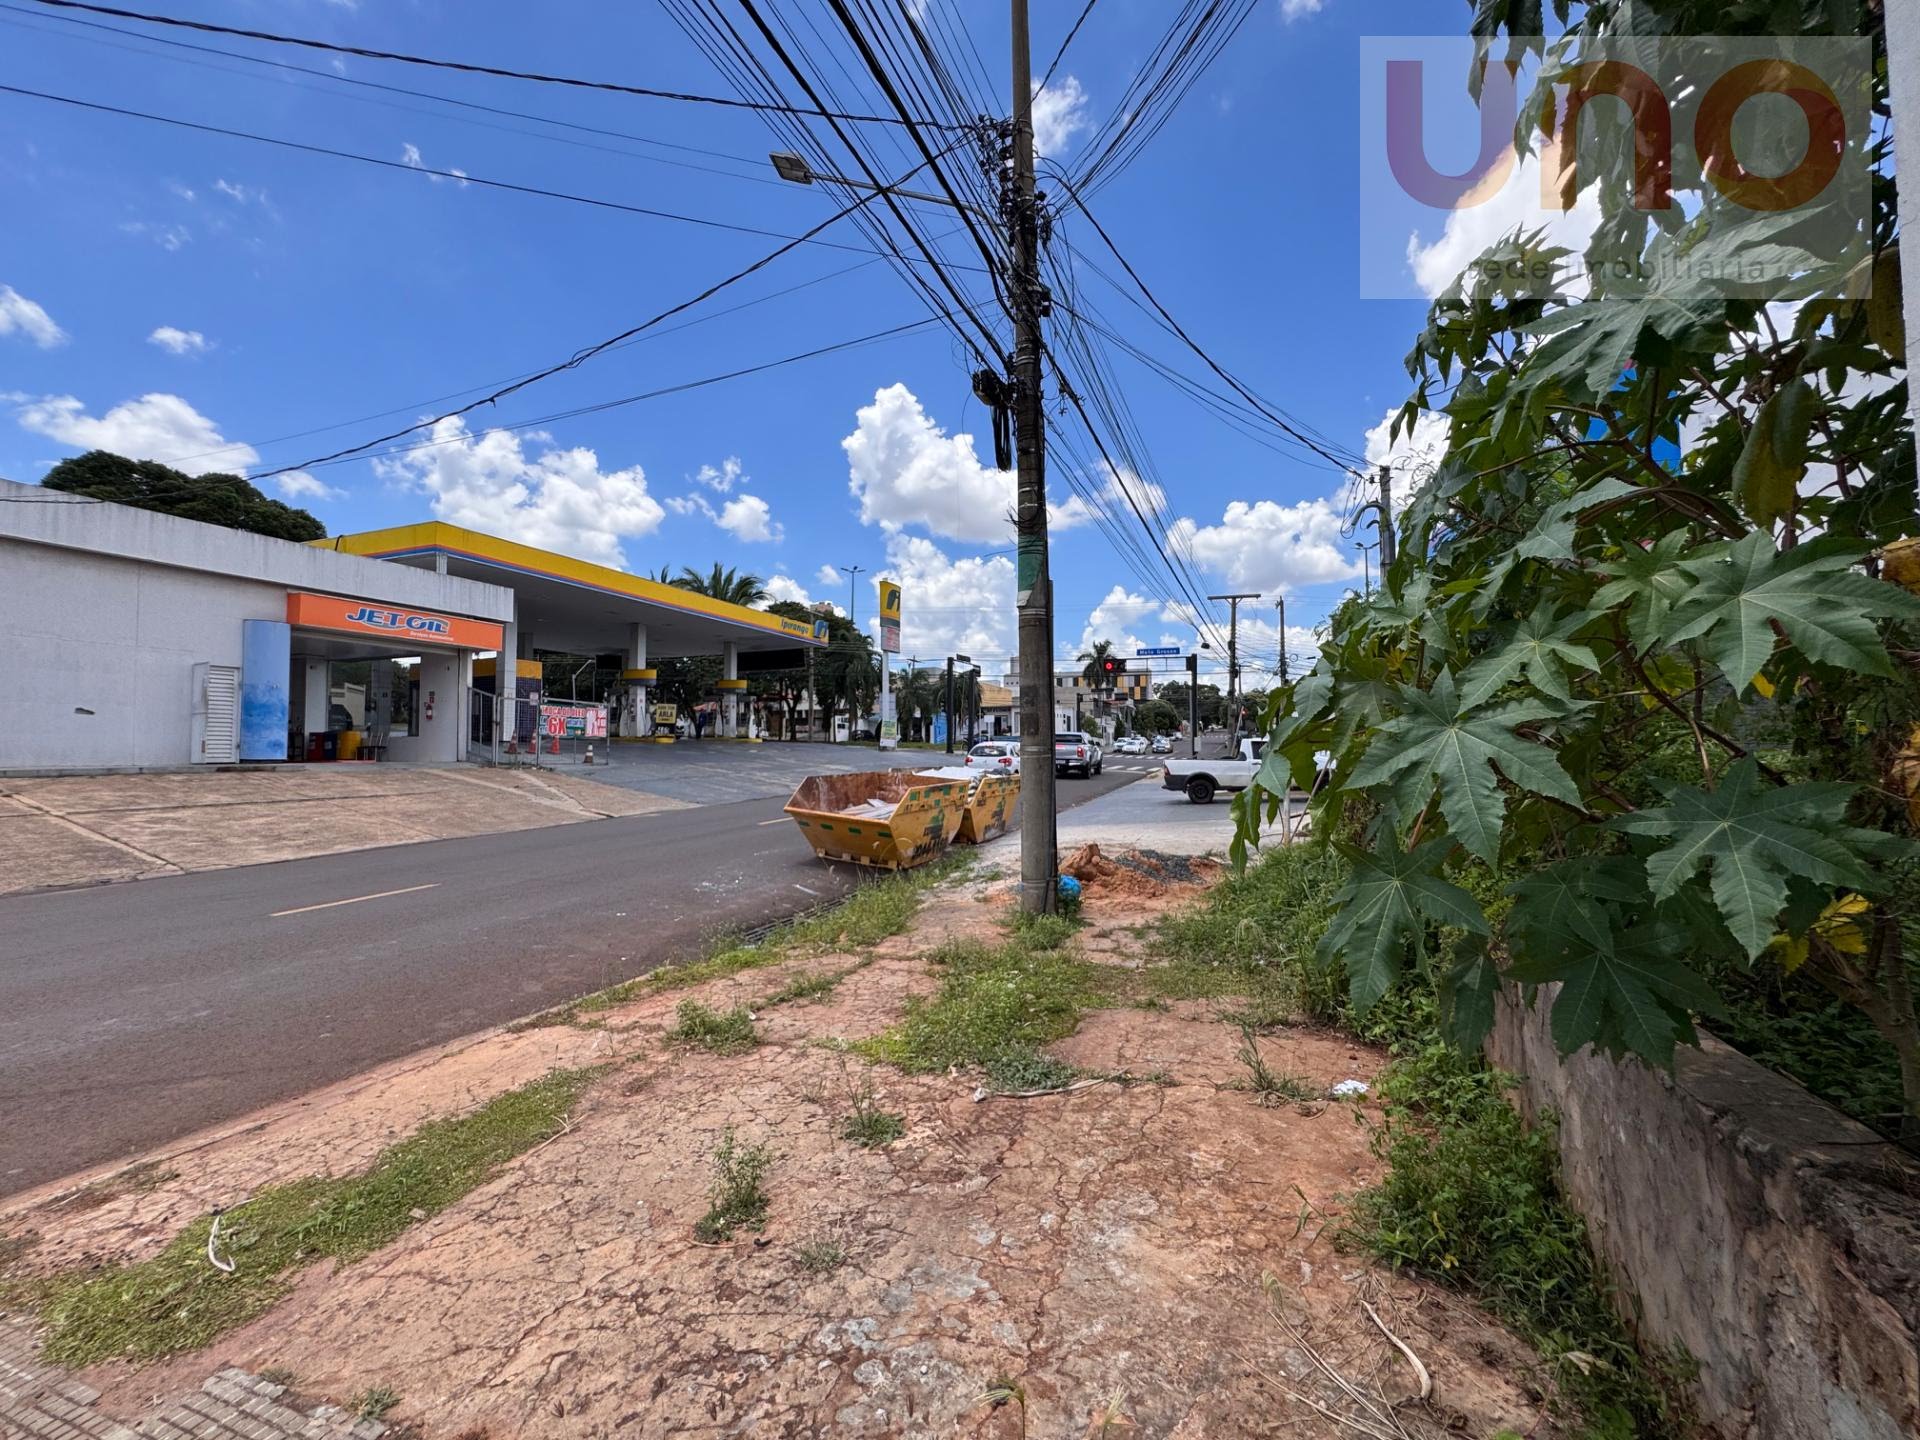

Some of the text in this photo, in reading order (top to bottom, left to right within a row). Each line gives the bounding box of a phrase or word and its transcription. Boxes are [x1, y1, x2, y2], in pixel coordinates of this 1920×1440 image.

[346, 607, 449, 634] JET OIL
[781, 618, 809, 634] Ipiranga
[548, 716, 567, 736] 6X
